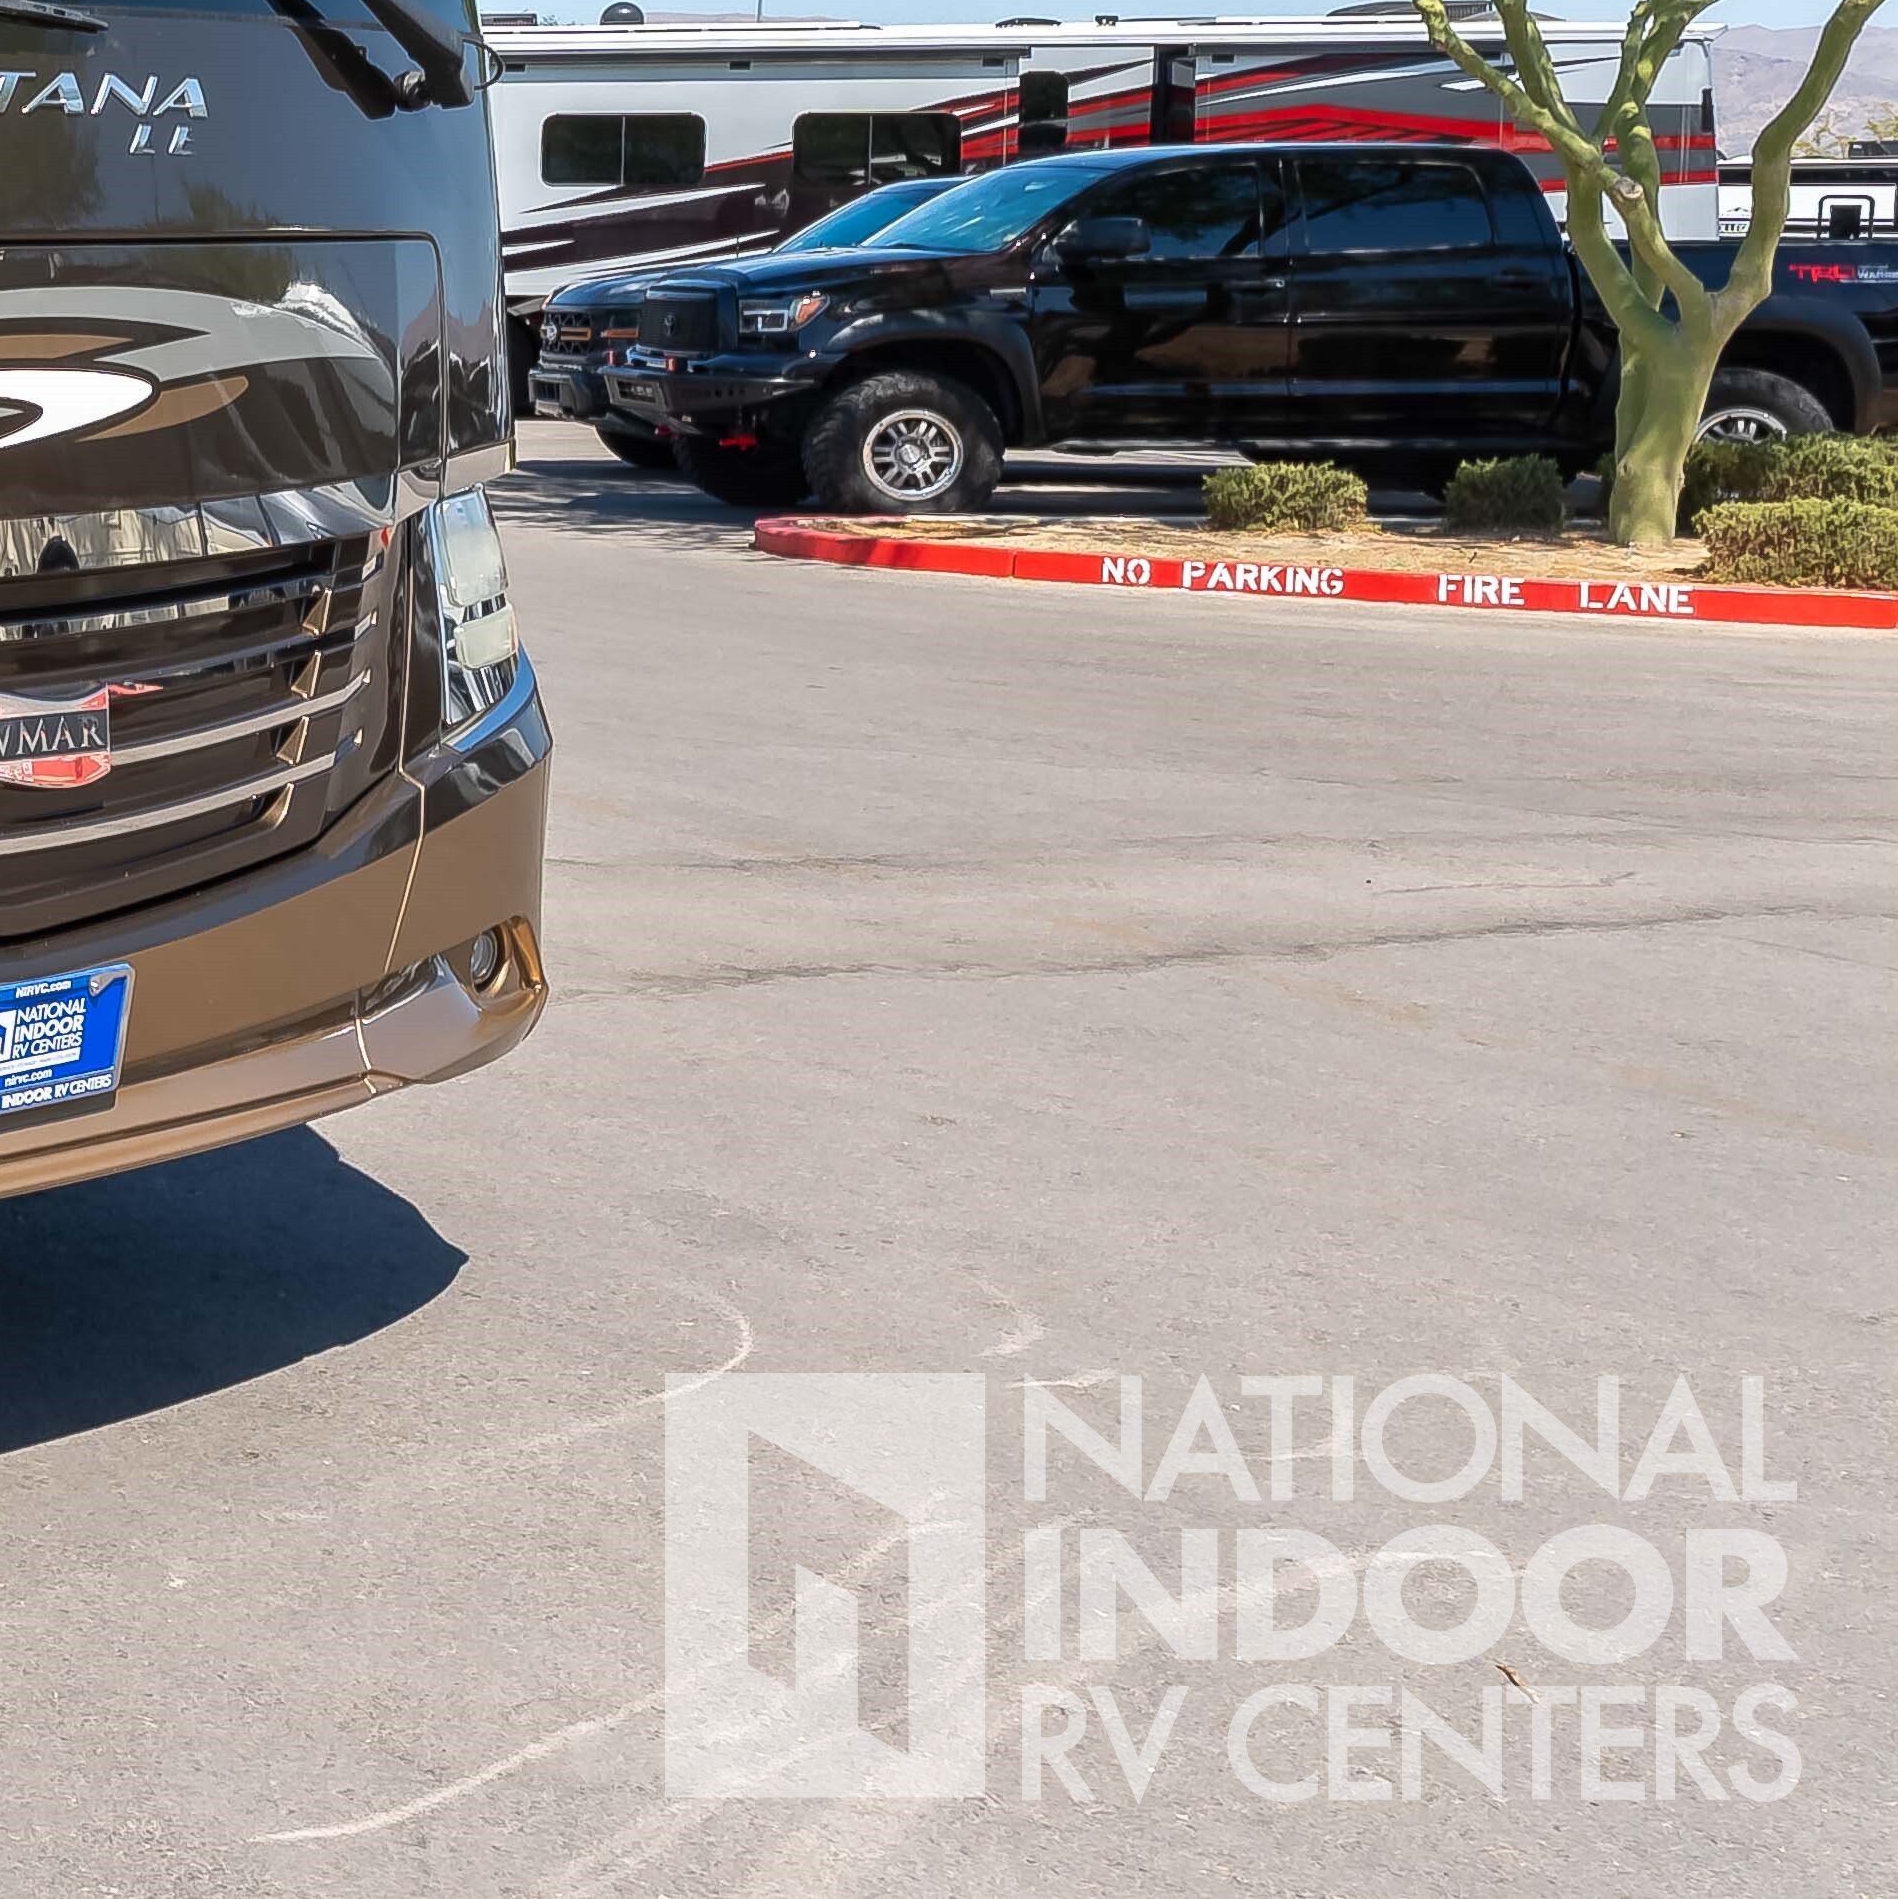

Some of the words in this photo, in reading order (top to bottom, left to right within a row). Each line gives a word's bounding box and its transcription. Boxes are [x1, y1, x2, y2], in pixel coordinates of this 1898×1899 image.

[129, 123, 195, 156] LE
[1102, 557, 1151, 584] NO
[1182, 560, 1344, 595] PARKING
[1438, 574, 1525, 605] FIRE
[1579, 581, 1695, 614] LANE
[15, 981, 71, 998] NIRVC.com
[17, 998, 86, 1024] NATIONAL
[14, 1015, 84, 1043] INDOOR
[12, 1042, 29, 1059] RV
[31, 1032, 82, 1055] CENTERS
[2, 1087, 52, 1108] INDOOR
[55, 1082, 69, 1098] RV
[69, 1074, 112, 1095] CENTERS
[5, 1069, 52, 1087] nirvc.com
